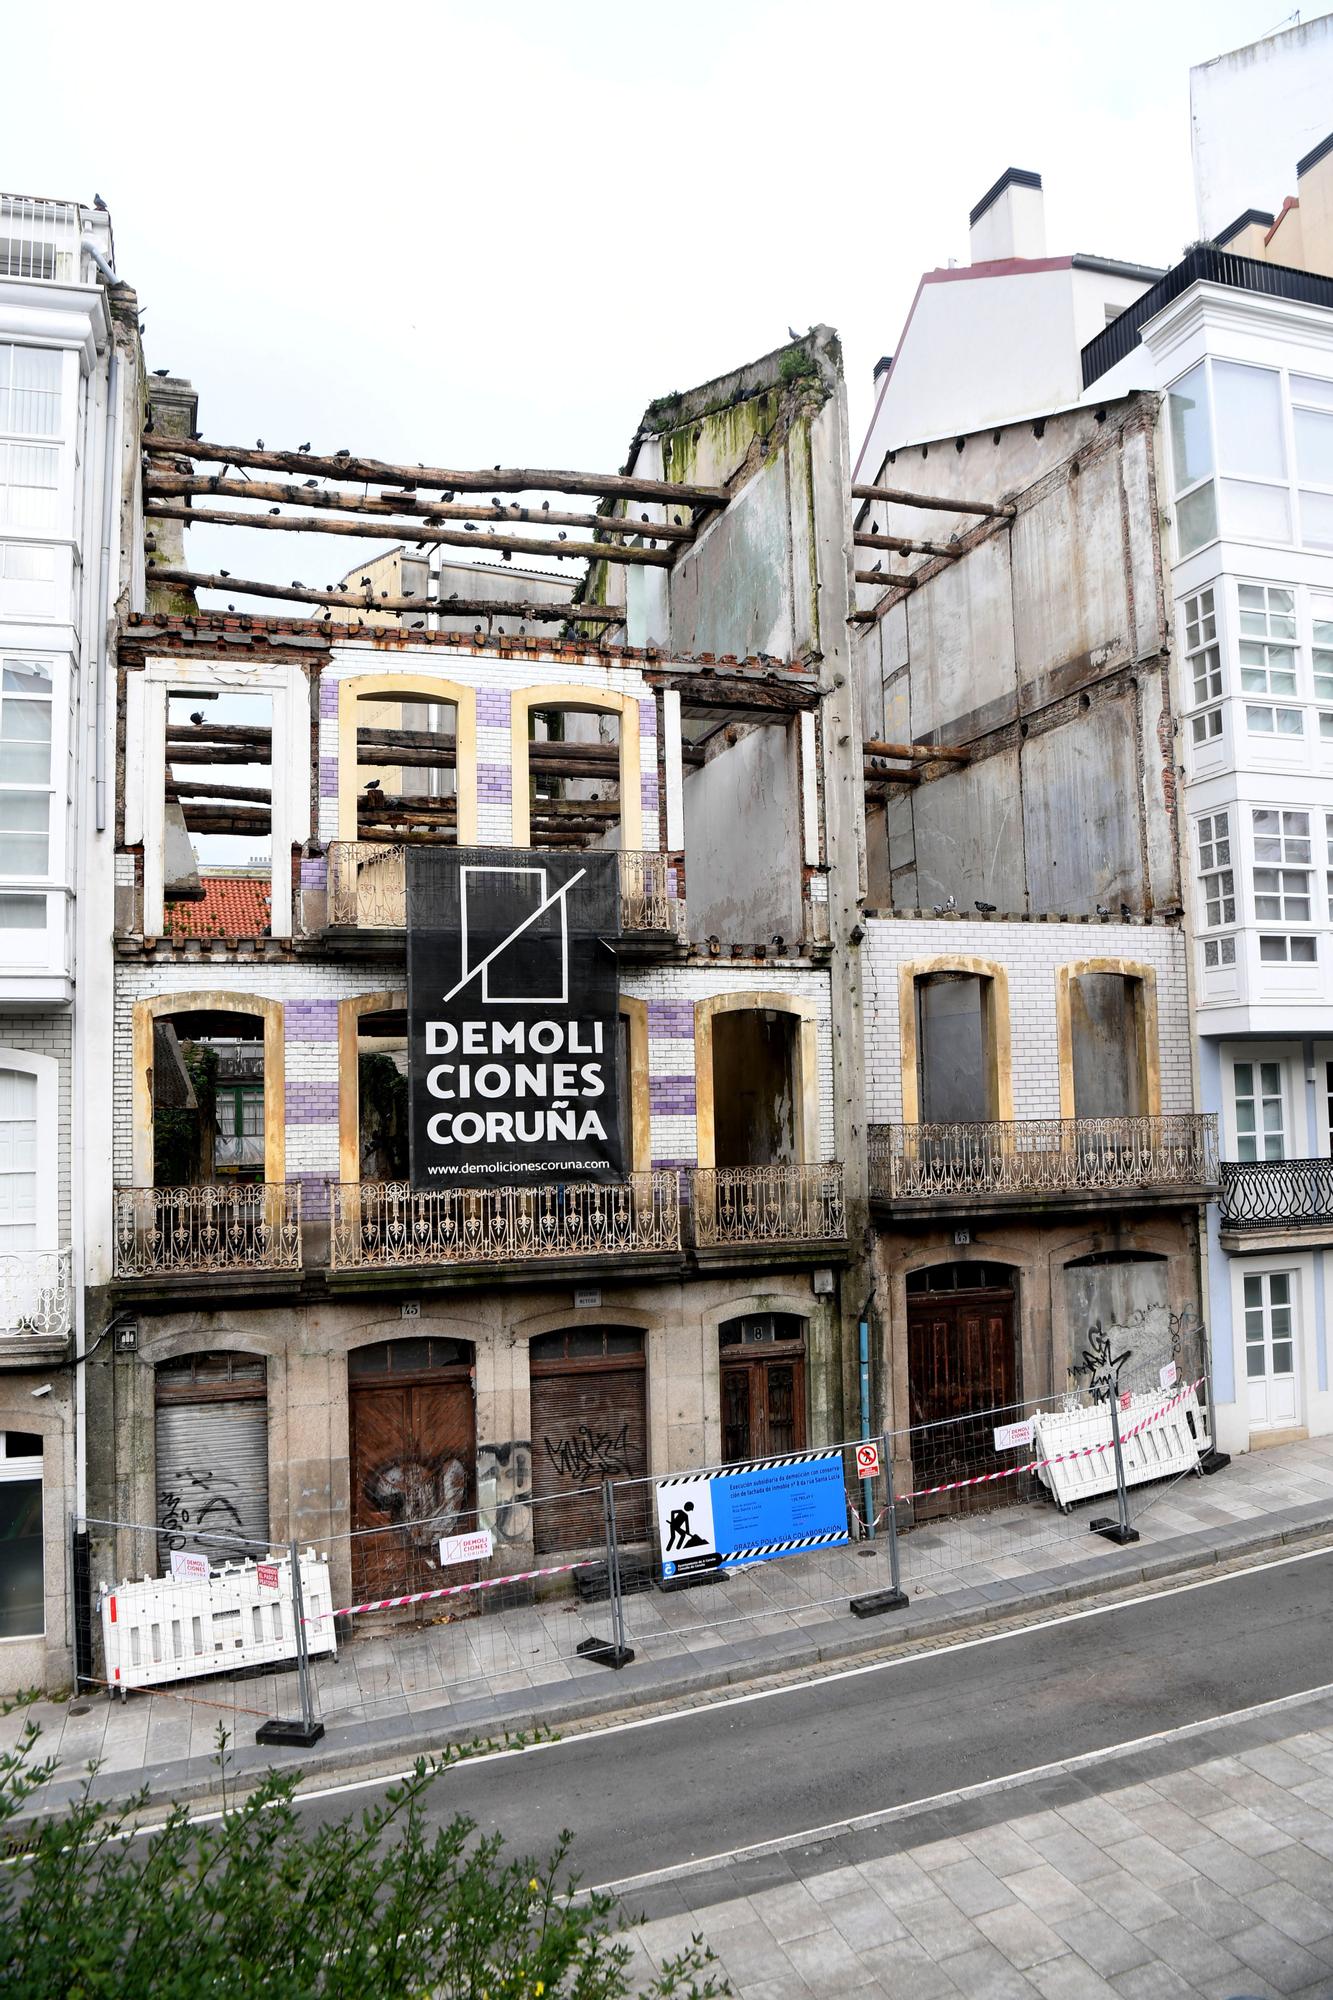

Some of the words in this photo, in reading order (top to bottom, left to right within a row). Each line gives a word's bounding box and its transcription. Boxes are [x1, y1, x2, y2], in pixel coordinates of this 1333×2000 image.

[425, 1020, 604, 1055] DEMOLI
[426, 1062, 605, 1099] CIONES
[426, 1100, 608, 1145] CORUÑA
[427, 1159, 610, 1175] www.demolicionescoruna.com
[755, 1327, 762, 1340] 8
[463, 1537, 488, 1547] DEMOLI
[733, 1541, 760, 1551] GRAZAS
[760, 1537, 778, 1546] POLA
[792, 1524, 842, 1539] COLABORACIÓN
[463, 1543, 488, 1552] CIONES
[186, 1559, 205, 1567] DEMOLI
[186, 1565, 206, 1573] CIONES
